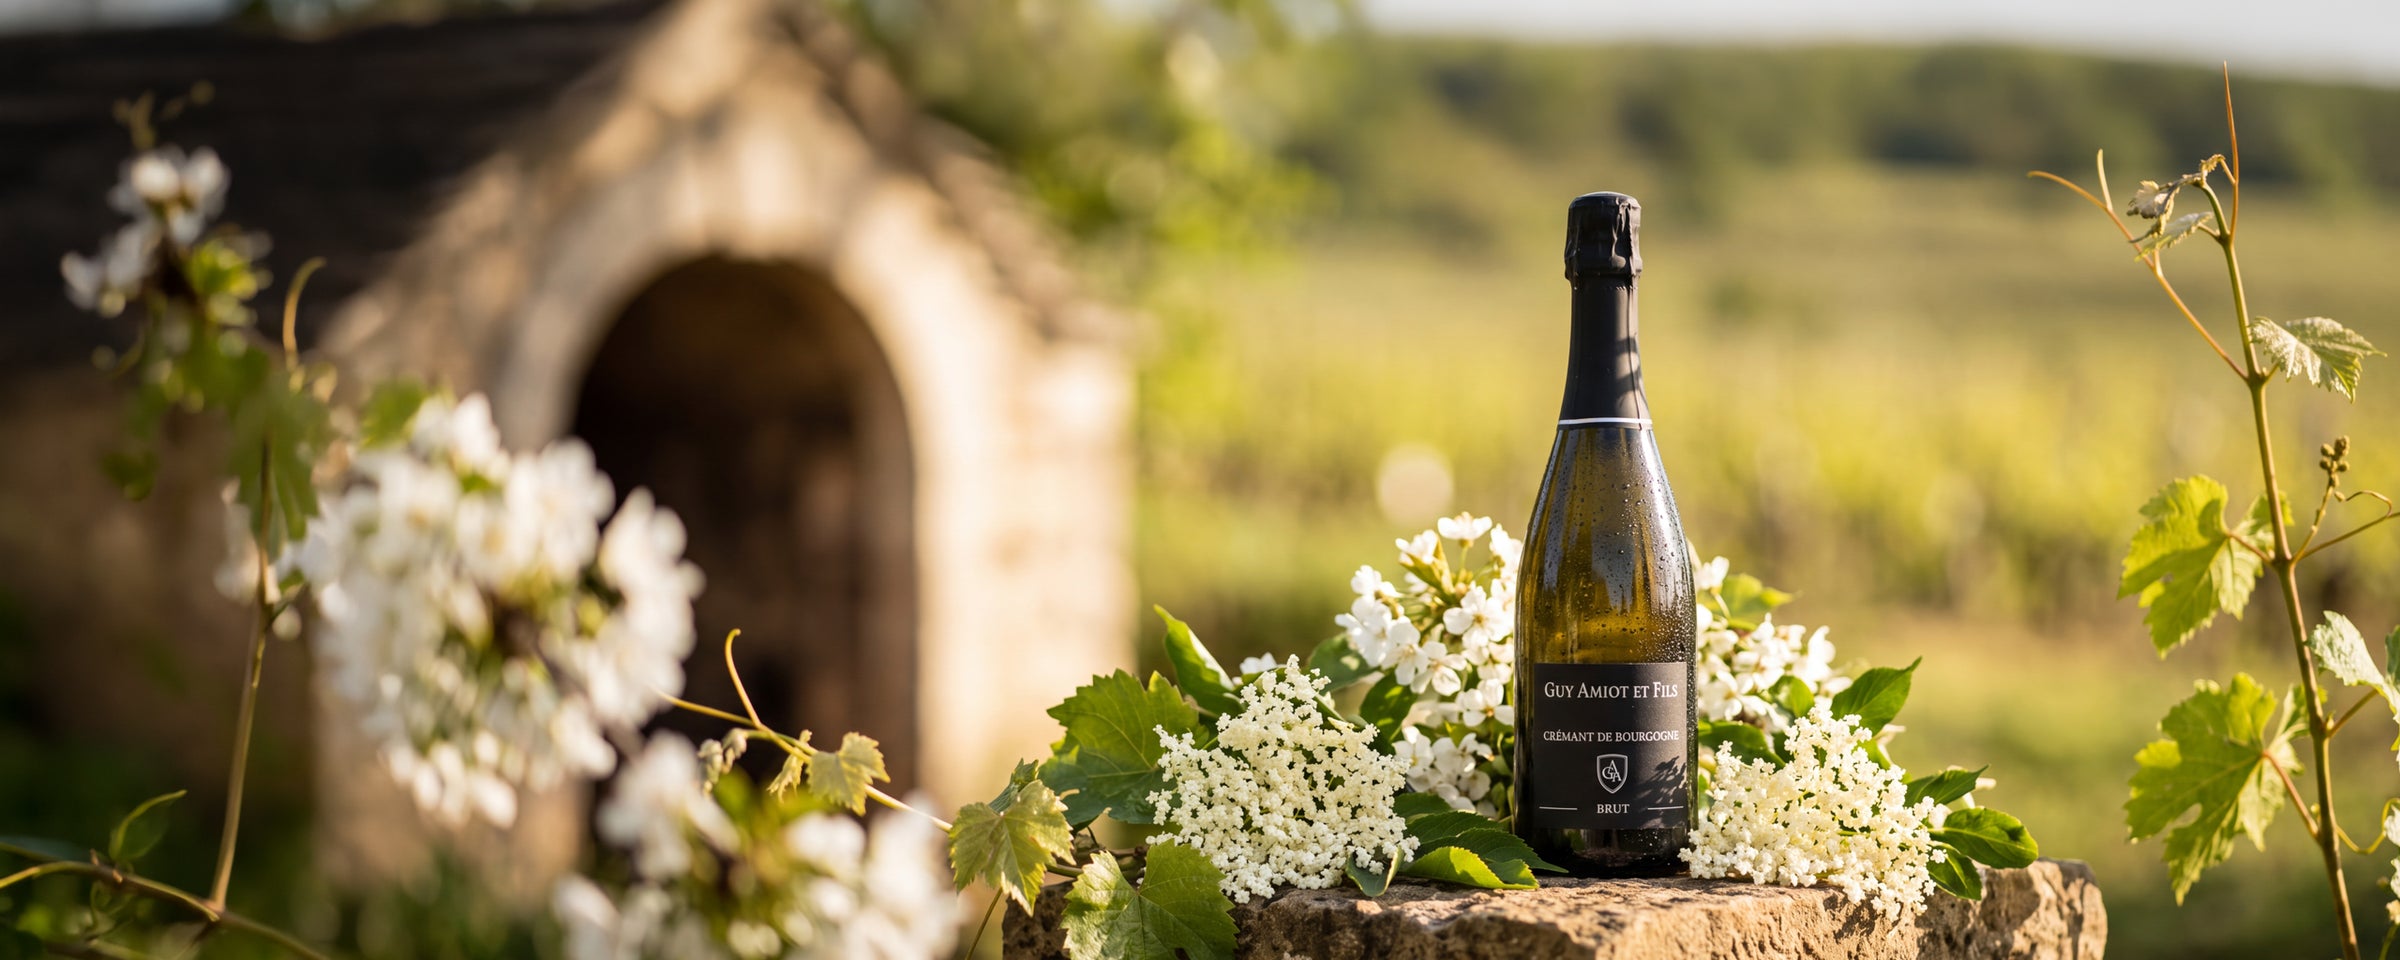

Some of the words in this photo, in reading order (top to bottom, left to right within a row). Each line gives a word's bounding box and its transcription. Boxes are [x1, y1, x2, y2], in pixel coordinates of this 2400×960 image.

[1633, 685, 1649, 698] ET
[1543, 729, 1594, 741] CRÉMANT
[1597, 732, 1612, 742] DE
[1615, 730, 1680, 742] BOURGOGNE
[1597, 803, 1630, 814] BRUT
